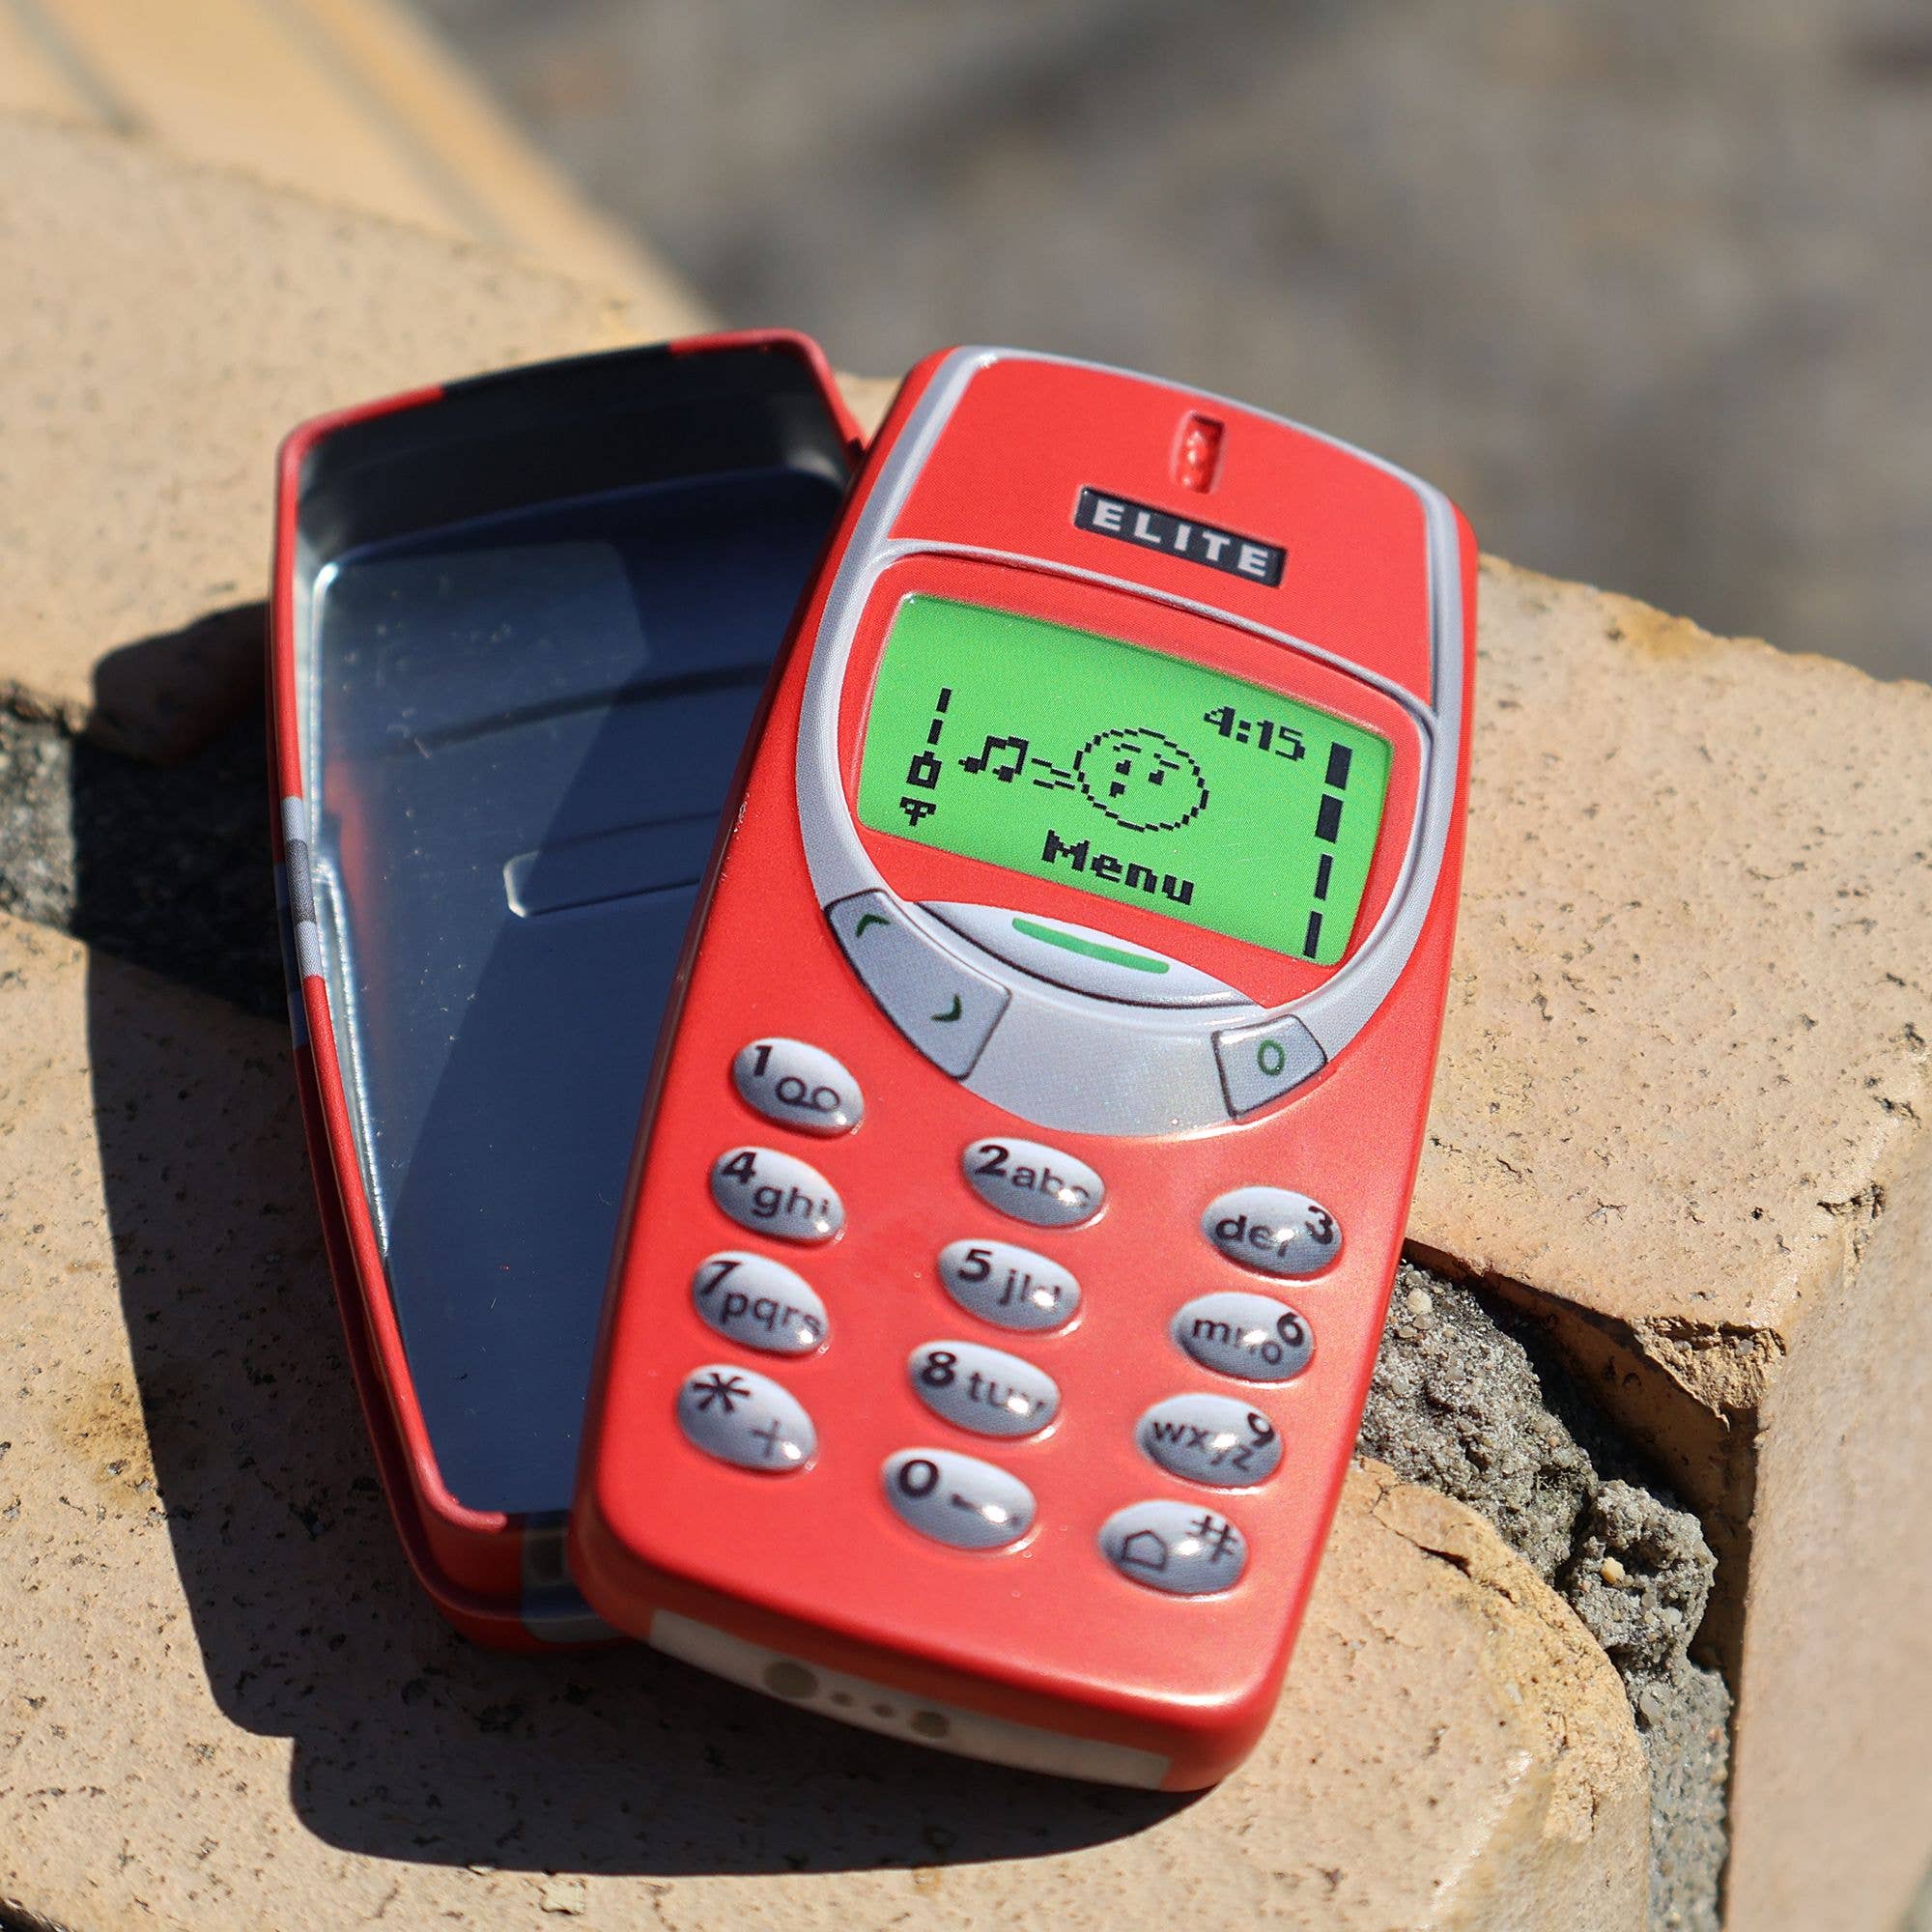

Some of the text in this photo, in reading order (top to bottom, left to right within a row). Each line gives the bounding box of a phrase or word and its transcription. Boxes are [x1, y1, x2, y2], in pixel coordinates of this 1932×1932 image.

[1092, 498, 1269, 578] ELITE
[1203, 705, 1306, 762] 4:15
[1040, 829, 1196, 906] Menu
[753, 1044, 773, 1077] 1
[721, 1151, 831, 1219] 4 ghi
[1305, 1205, 1334, 1245] 3
[956, 1248, 993, 1283] 5
[701, 1260, 821, 1339] 7 pqrs
[1276, 1311, 1305, 1348] 6
[921, 1350, 957, 1388] 8
[1246, 1411, 1275, 1448] 9
[898, 1459, 940, 1498] 0
